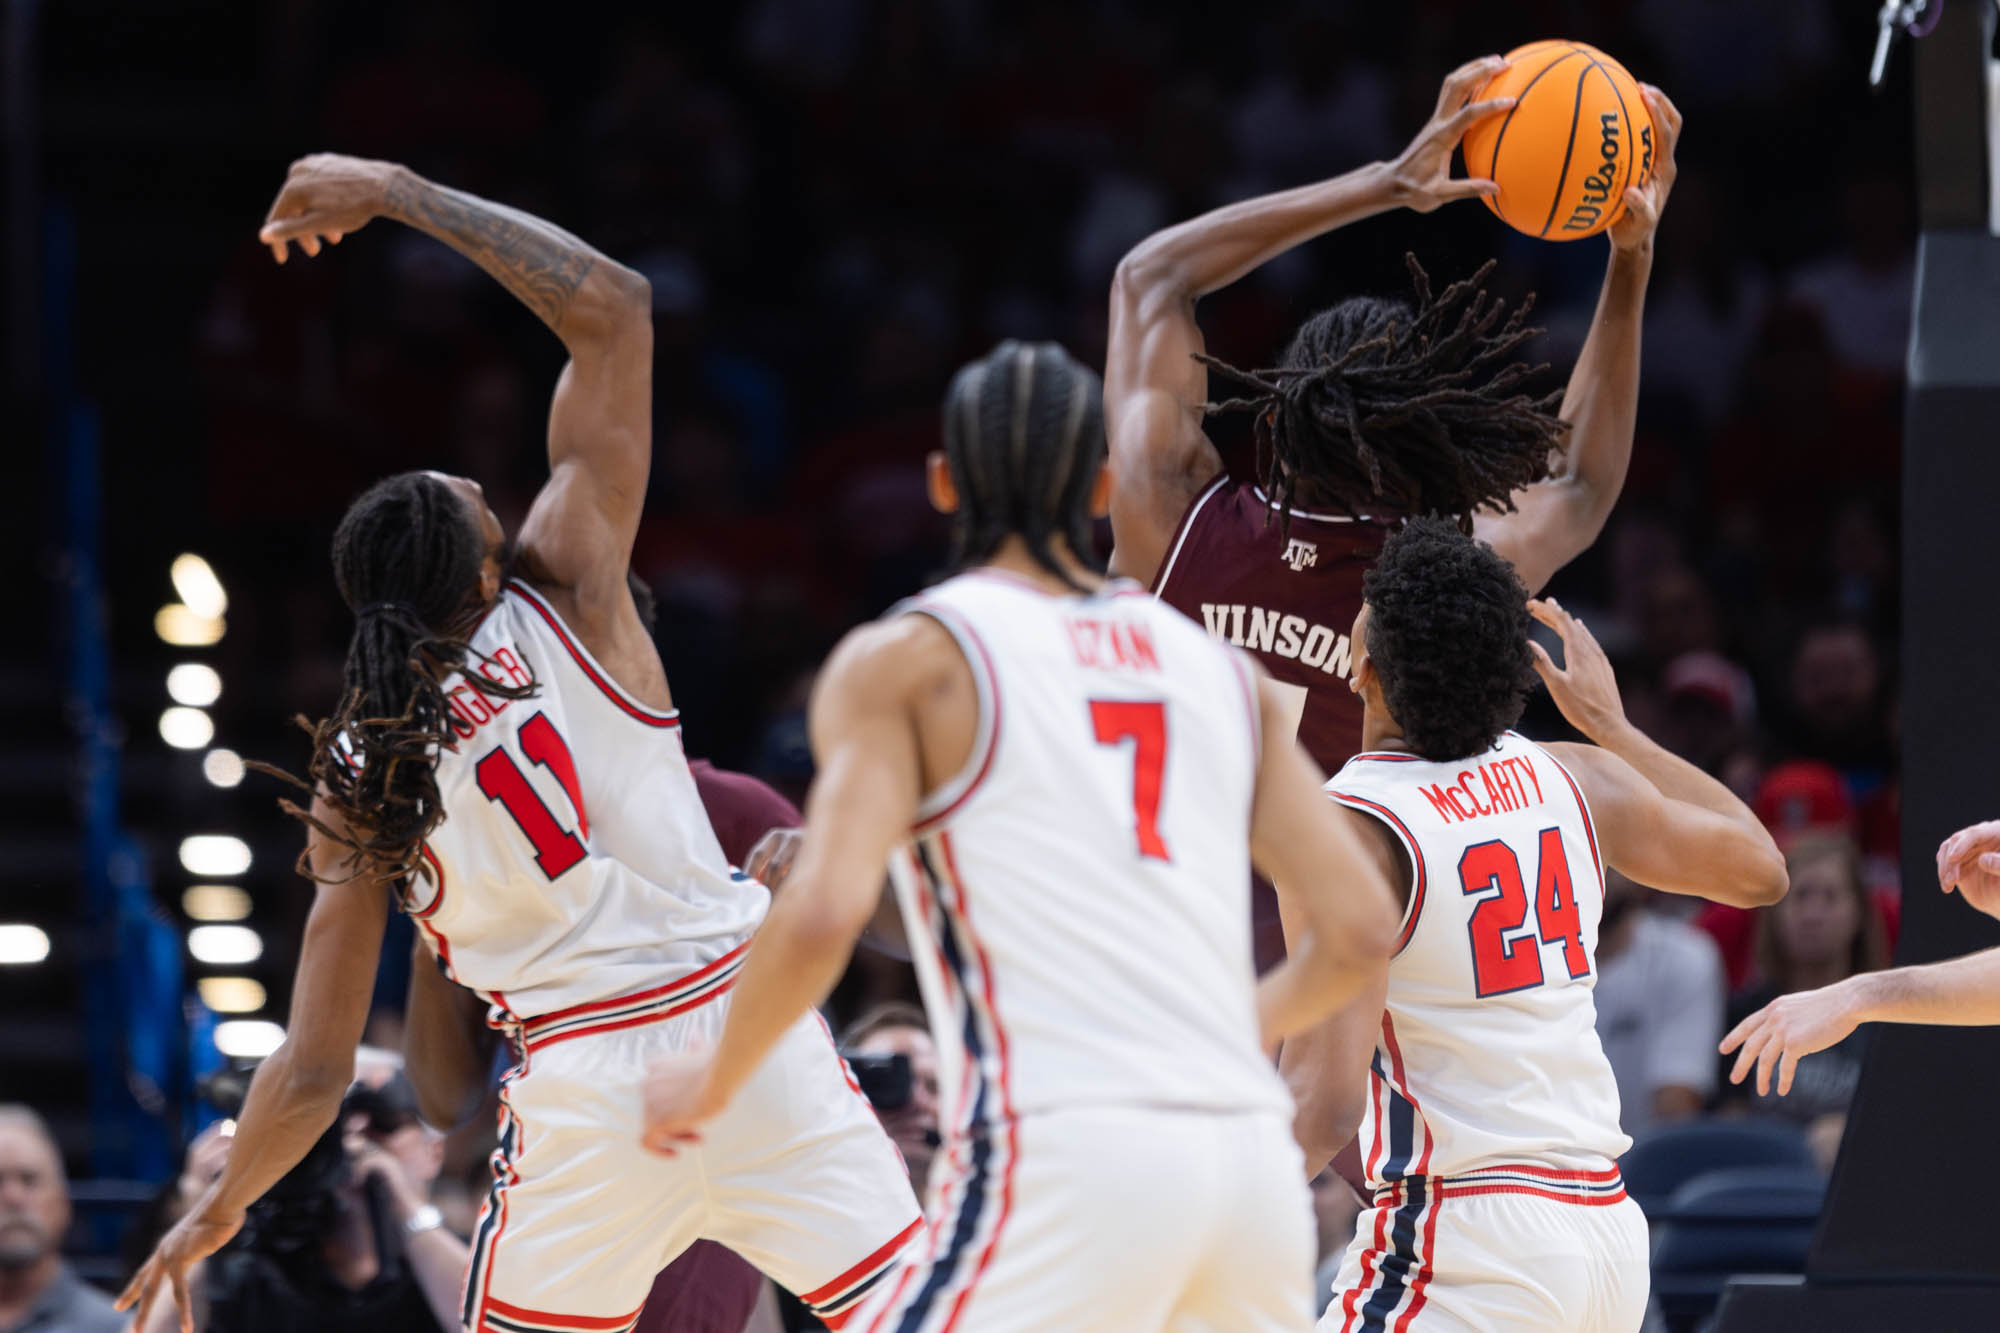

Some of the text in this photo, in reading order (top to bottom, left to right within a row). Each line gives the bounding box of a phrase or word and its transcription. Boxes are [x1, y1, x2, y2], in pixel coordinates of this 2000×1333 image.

[1562, 112, 1619, 230] Wilson
[1201, 603, 1351, 679] VINSON
[475, 710, 590, 882] 11
[1088, 698, 1173, 862] 7
[1417, 755, 1544, 824] McCARTY
[1457, 826, 1591, 999] 24
